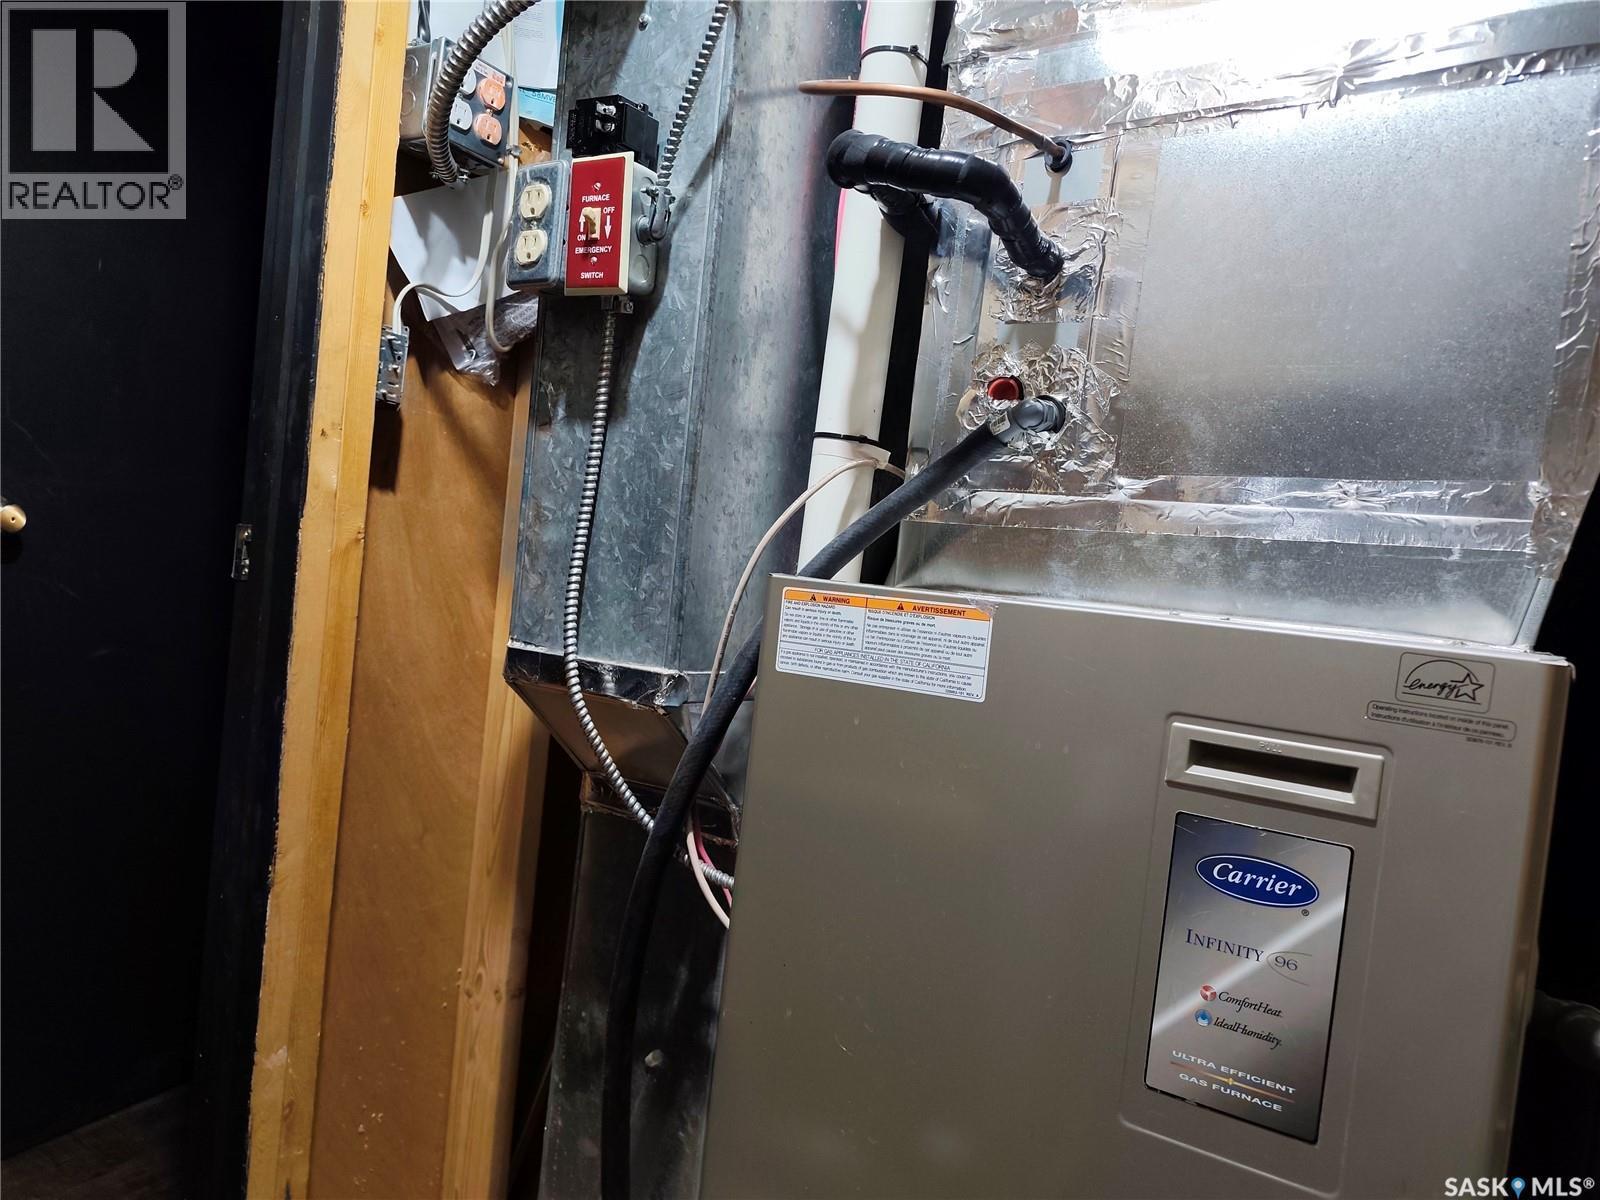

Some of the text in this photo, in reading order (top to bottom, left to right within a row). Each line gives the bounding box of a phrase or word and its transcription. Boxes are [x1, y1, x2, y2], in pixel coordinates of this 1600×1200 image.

[582, 194, 610, 202] FURNACE
[575, 246, 612, 254] EMERGENCY
[822, 595, 850, 604] WARNING
[912, 605, 966, 616] AVERTISSEMENT
[1404, 678, 1457, 698] energy
[1212, 863, 1302, 896] Carrier
[1186, 928, 1298, 972] INFINITY 96
[1172, 1050, 1296, 1094] ULTRA EFFICIENT
[1179, 1073, 1283, 1112] GAS FURNACE
